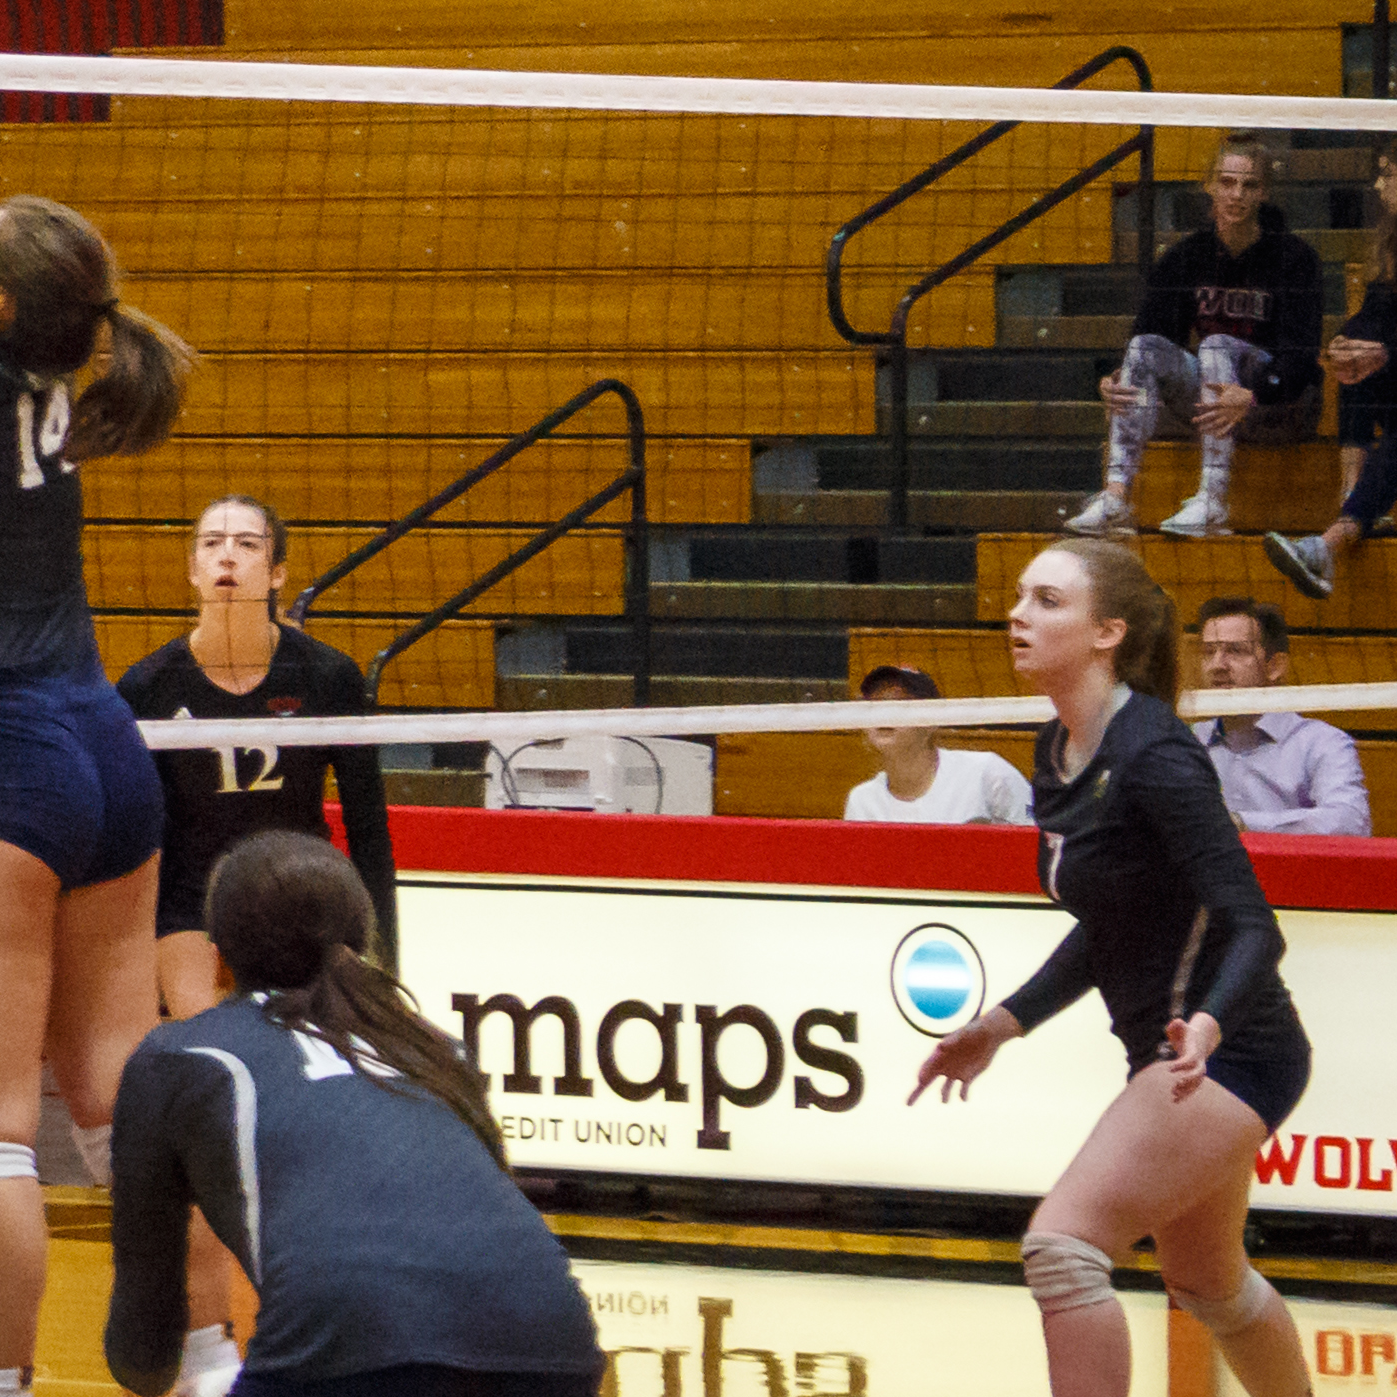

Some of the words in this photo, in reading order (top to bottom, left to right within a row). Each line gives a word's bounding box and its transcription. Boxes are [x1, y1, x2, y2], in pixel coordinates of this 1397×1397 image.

[211, 745, 285, 794] 12
[451, 991, 866, 1152] maps
[502, 1115, 564, 1142] EDIT
[574, 1119, 668, 1148] UNION
[1255, 1133, 1397, 1192] WOL
